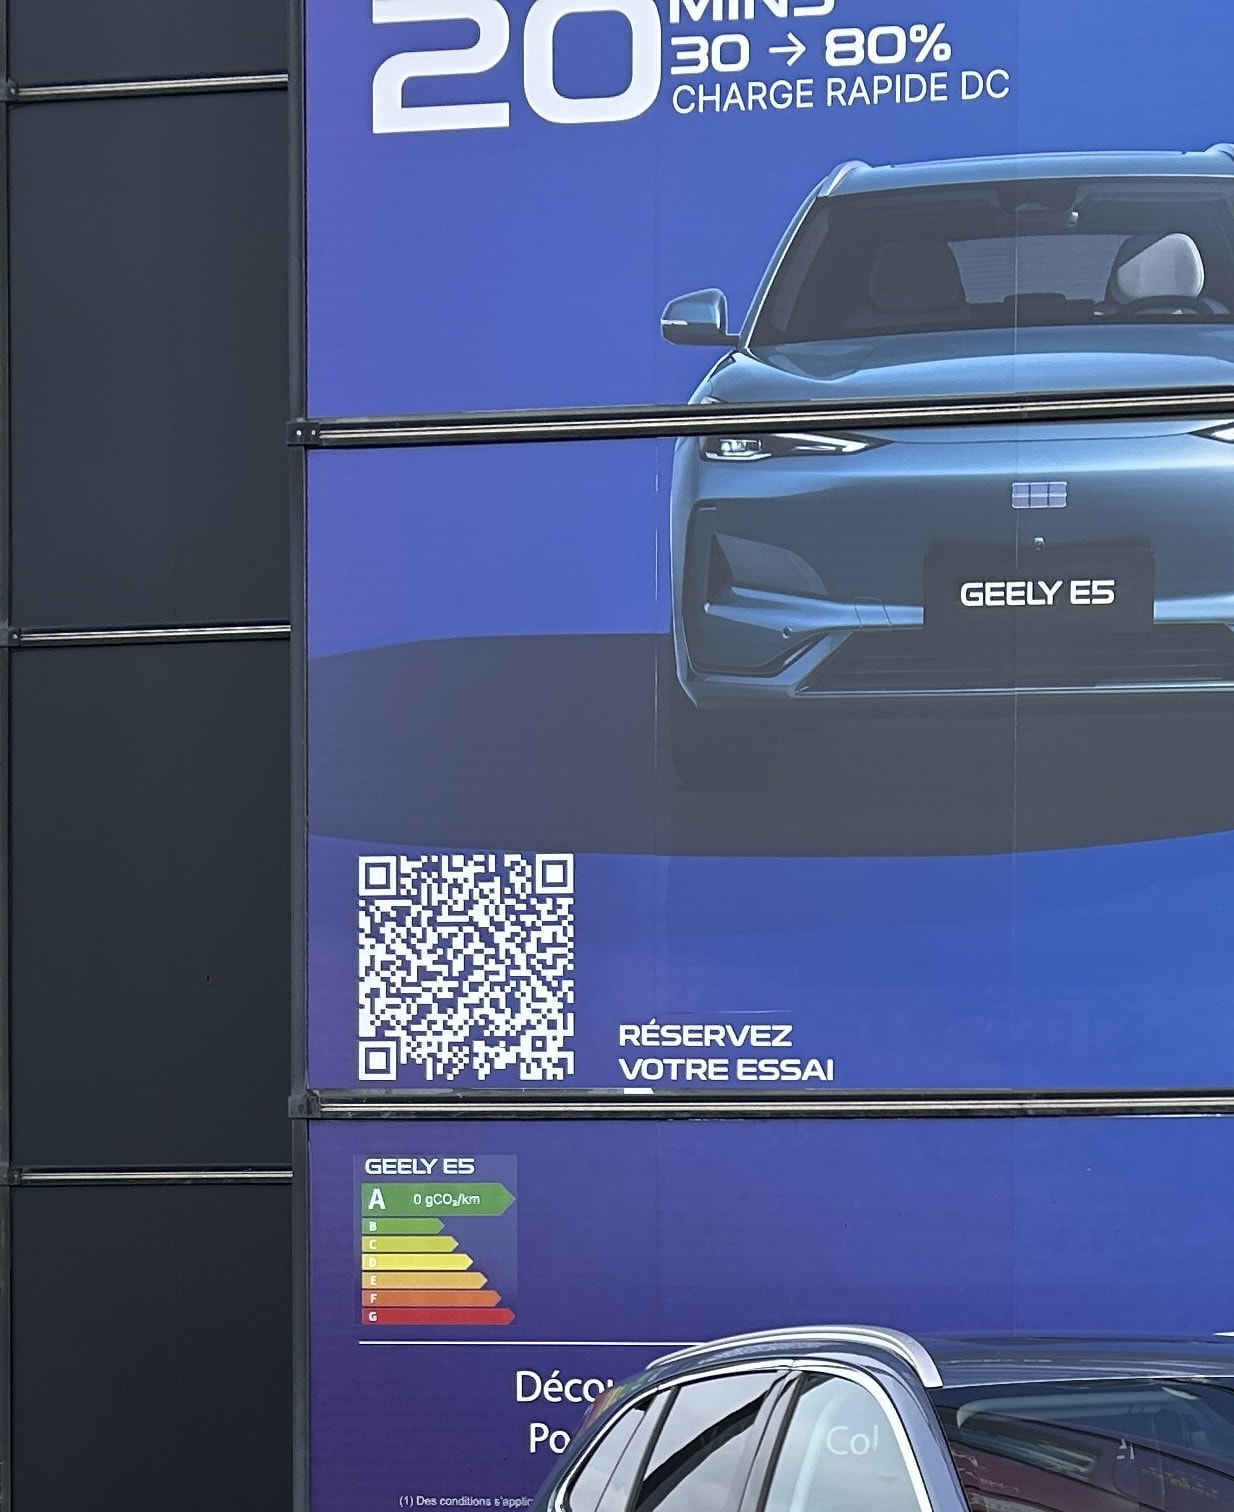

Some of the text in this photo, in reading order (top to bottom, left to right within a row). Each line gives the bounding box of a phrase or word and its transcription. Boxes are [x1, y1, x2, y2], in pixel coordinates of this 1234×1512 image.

[671, 23, 951, 74] 30 80%
[373, 0, 661, 133] 20
[673, 70, 1009, 113] CHARGE RAPIDE DC
[961, 580, 1114, 606] GEELY E5
[619, 1019, 792, 1046] RÉSERVEZ
[619, 1059, 833, 1081] VOTRE ESSAI
[365, 1158, 474, 1174] GEELY E5
[368, 1189, 386, 1209] A
[414, 1194, 421, 1204] 0
[369, 1221, 377, 1231] B
[369, 1239, 377, 1250] C
[369, 1257, 377, 1268] D
[370, 1275, 377, 1286] E
[370, 1293, 378, 1304] F
[368, 1311, 378, 1322] G
[400, 1496, 414, 1508] (1)
[417, 1496, 437, 1506] Des
[440, 1496, 491, 1506] conditions
